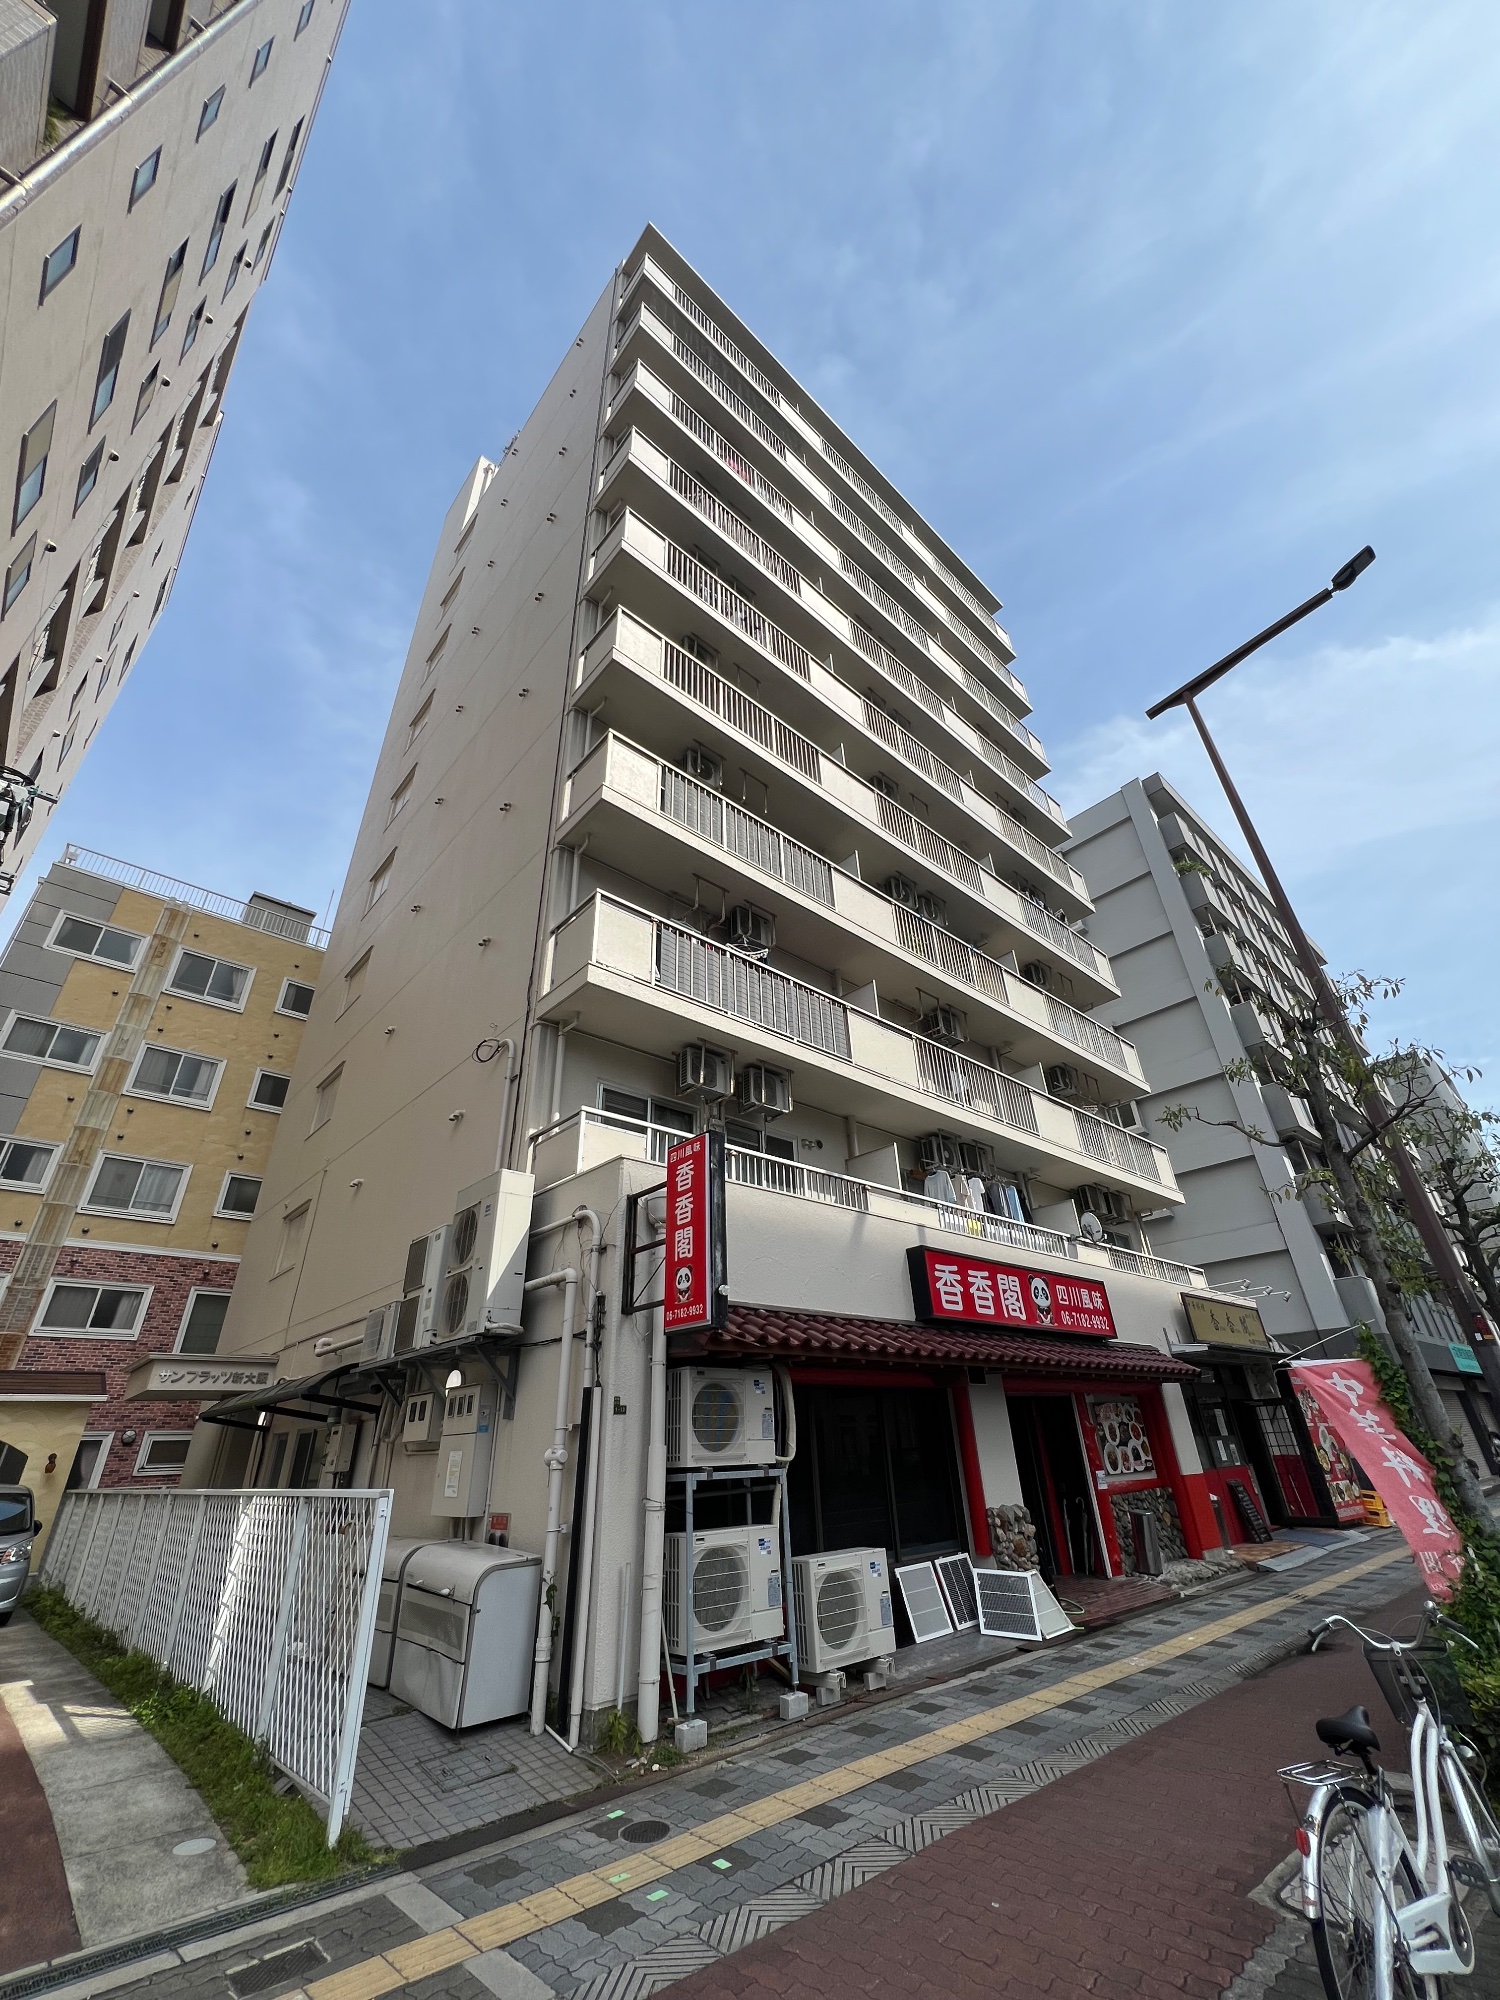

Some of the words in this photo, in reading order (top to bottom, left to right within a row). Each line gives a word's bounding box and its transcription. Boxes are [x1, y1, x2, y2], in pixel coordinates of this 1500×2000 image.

[670, 1141, 701, 1163] 四川風味
[674, 1159, 695, 1262] 香香閣
[934, 1263, 1027, 1321] 香香閣
[1055, 1284, 1106, 1312] 四川風味
[666, 1303, 704, 1321] 06-7182-9932
[1060, 1310, 1110, 1330] 06-7182-9932
[159, 1369, 270, 1385] サンフラッツ新大阪
